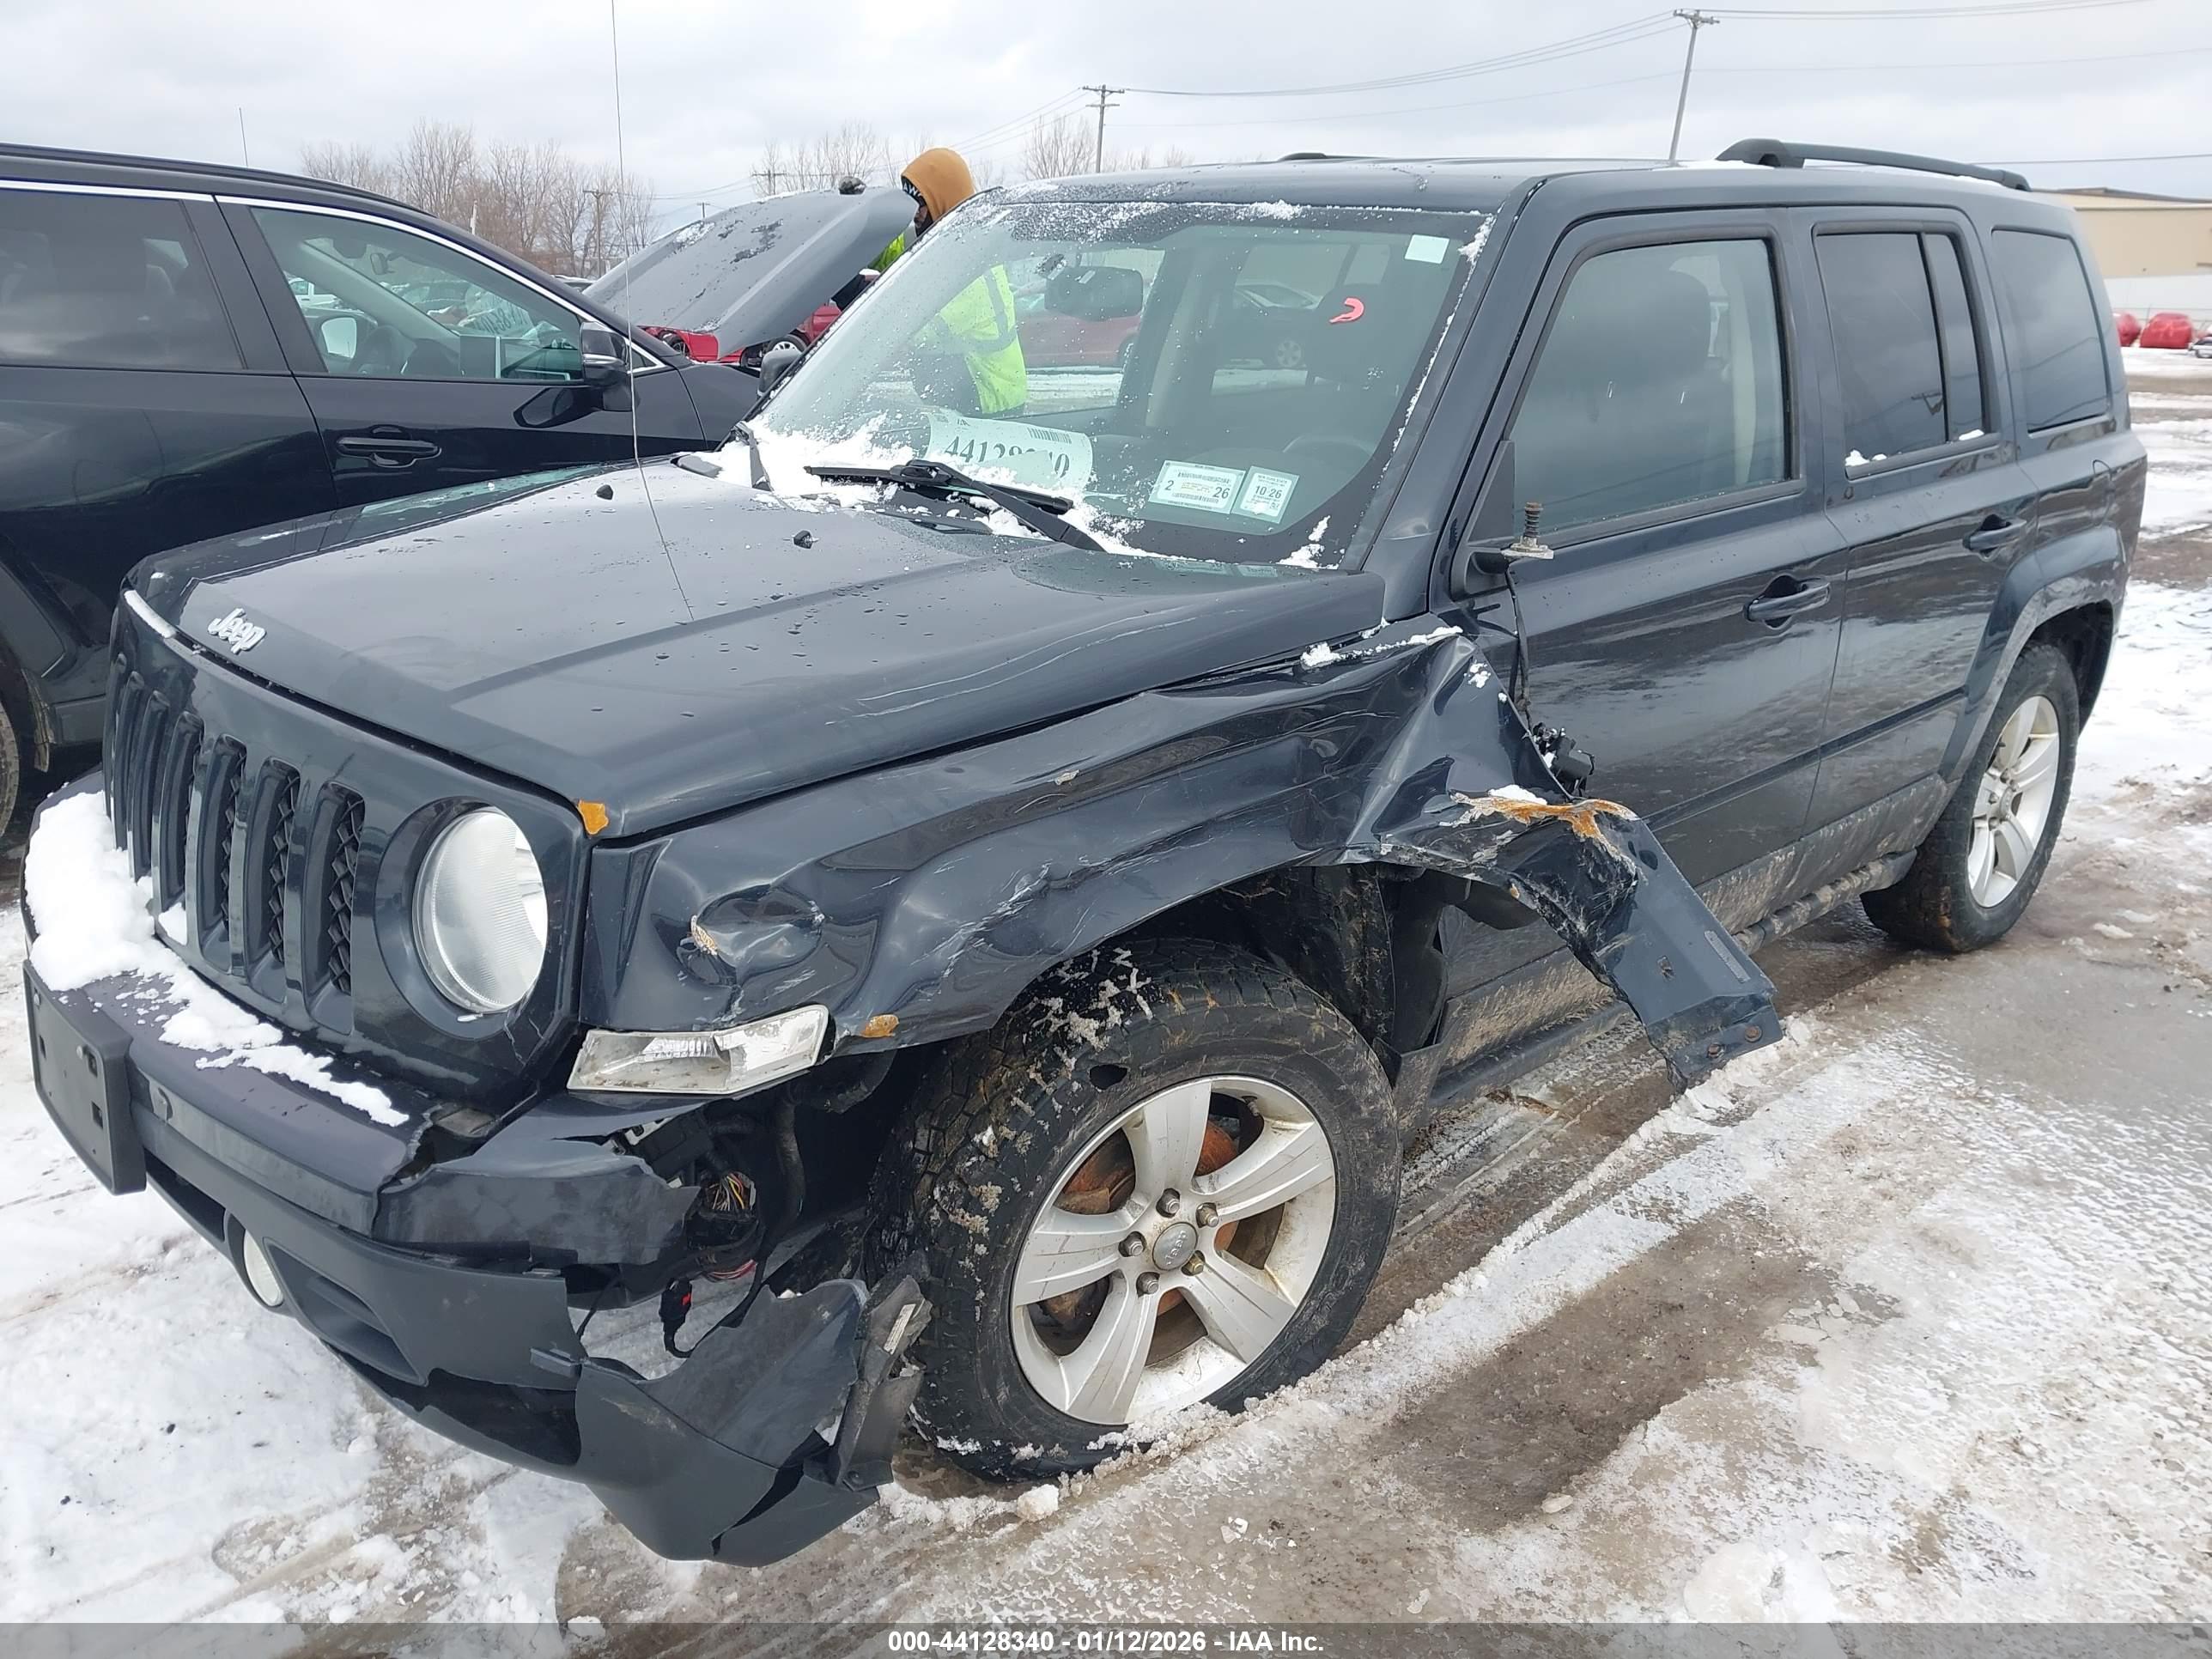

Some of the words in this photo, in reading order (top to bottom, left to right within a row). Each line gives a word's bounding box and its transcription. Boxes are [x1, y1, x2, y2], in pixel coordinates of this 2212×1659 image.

[944, 435, 1070, 478] 44120
[1164, 480, 1175, 491] 2
[1212, 487, 1231, 499] 26
[1255, 485, 1267, 495] 10
[1268, 488, 1283, 499] 26
[208, 608, 266, 654] Jeep
